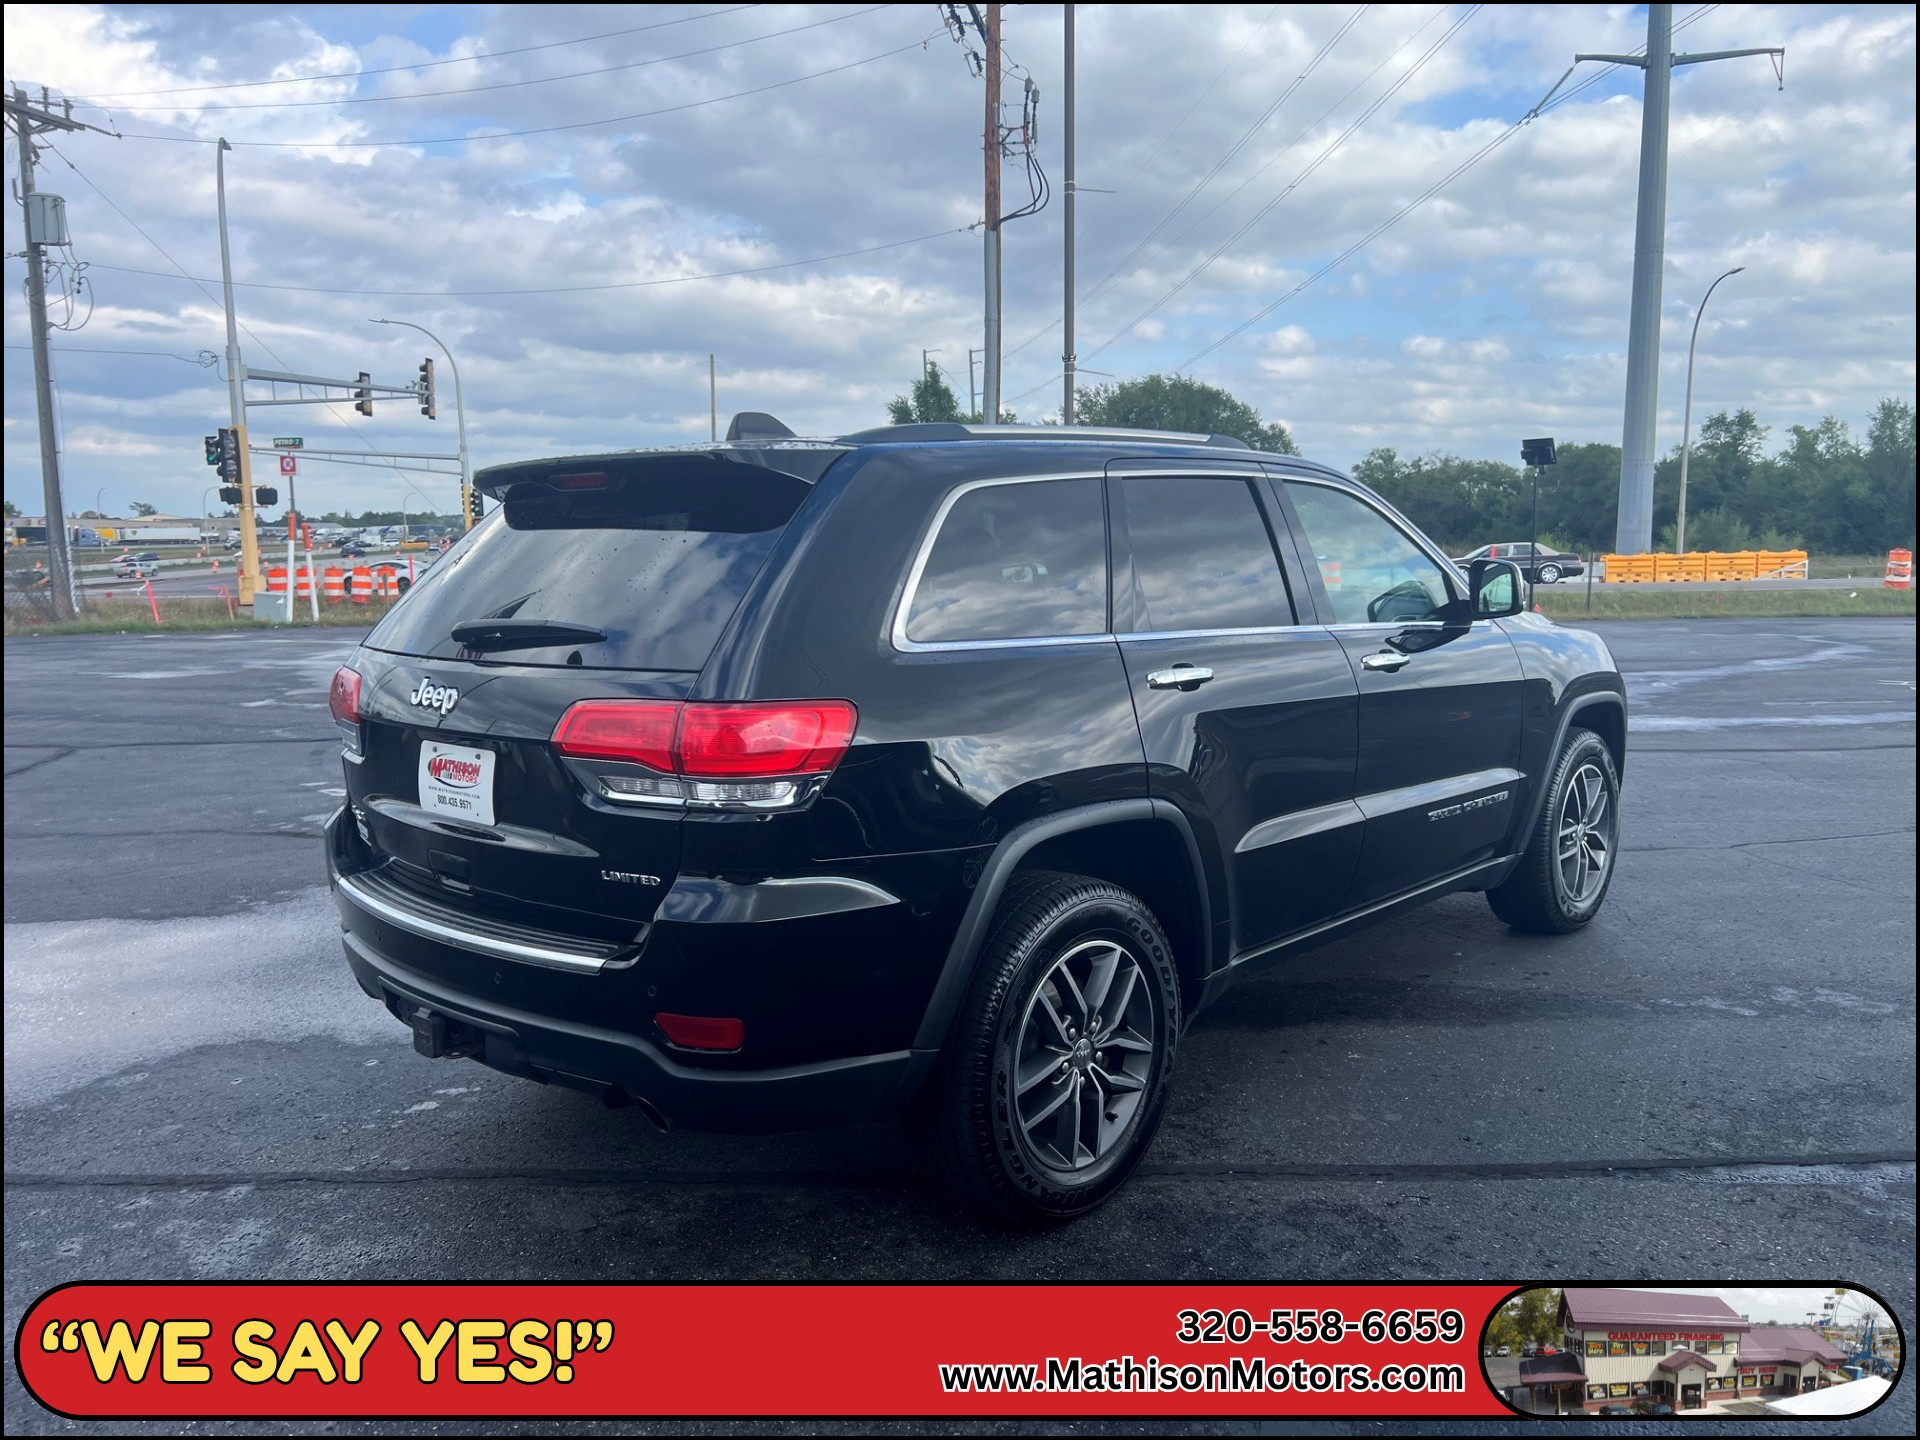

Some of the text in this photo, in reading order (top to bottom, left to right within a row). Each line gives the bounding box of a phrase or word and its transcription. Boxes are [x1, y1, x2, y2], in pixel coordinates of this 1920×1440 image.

[410, 676, 459, 717] Jeep
[429, 757, 481, 777] MATHISON
[452, 772, 478, 785] MOTORS
[437, 794, 472, 810] 800.435.9571
[601, 870, 661, 886] LIMITED
[1607, 1331, 1725, 1341] GUARANTEED FINANCING
[1740, 1367, 1756, 1375] BUY
